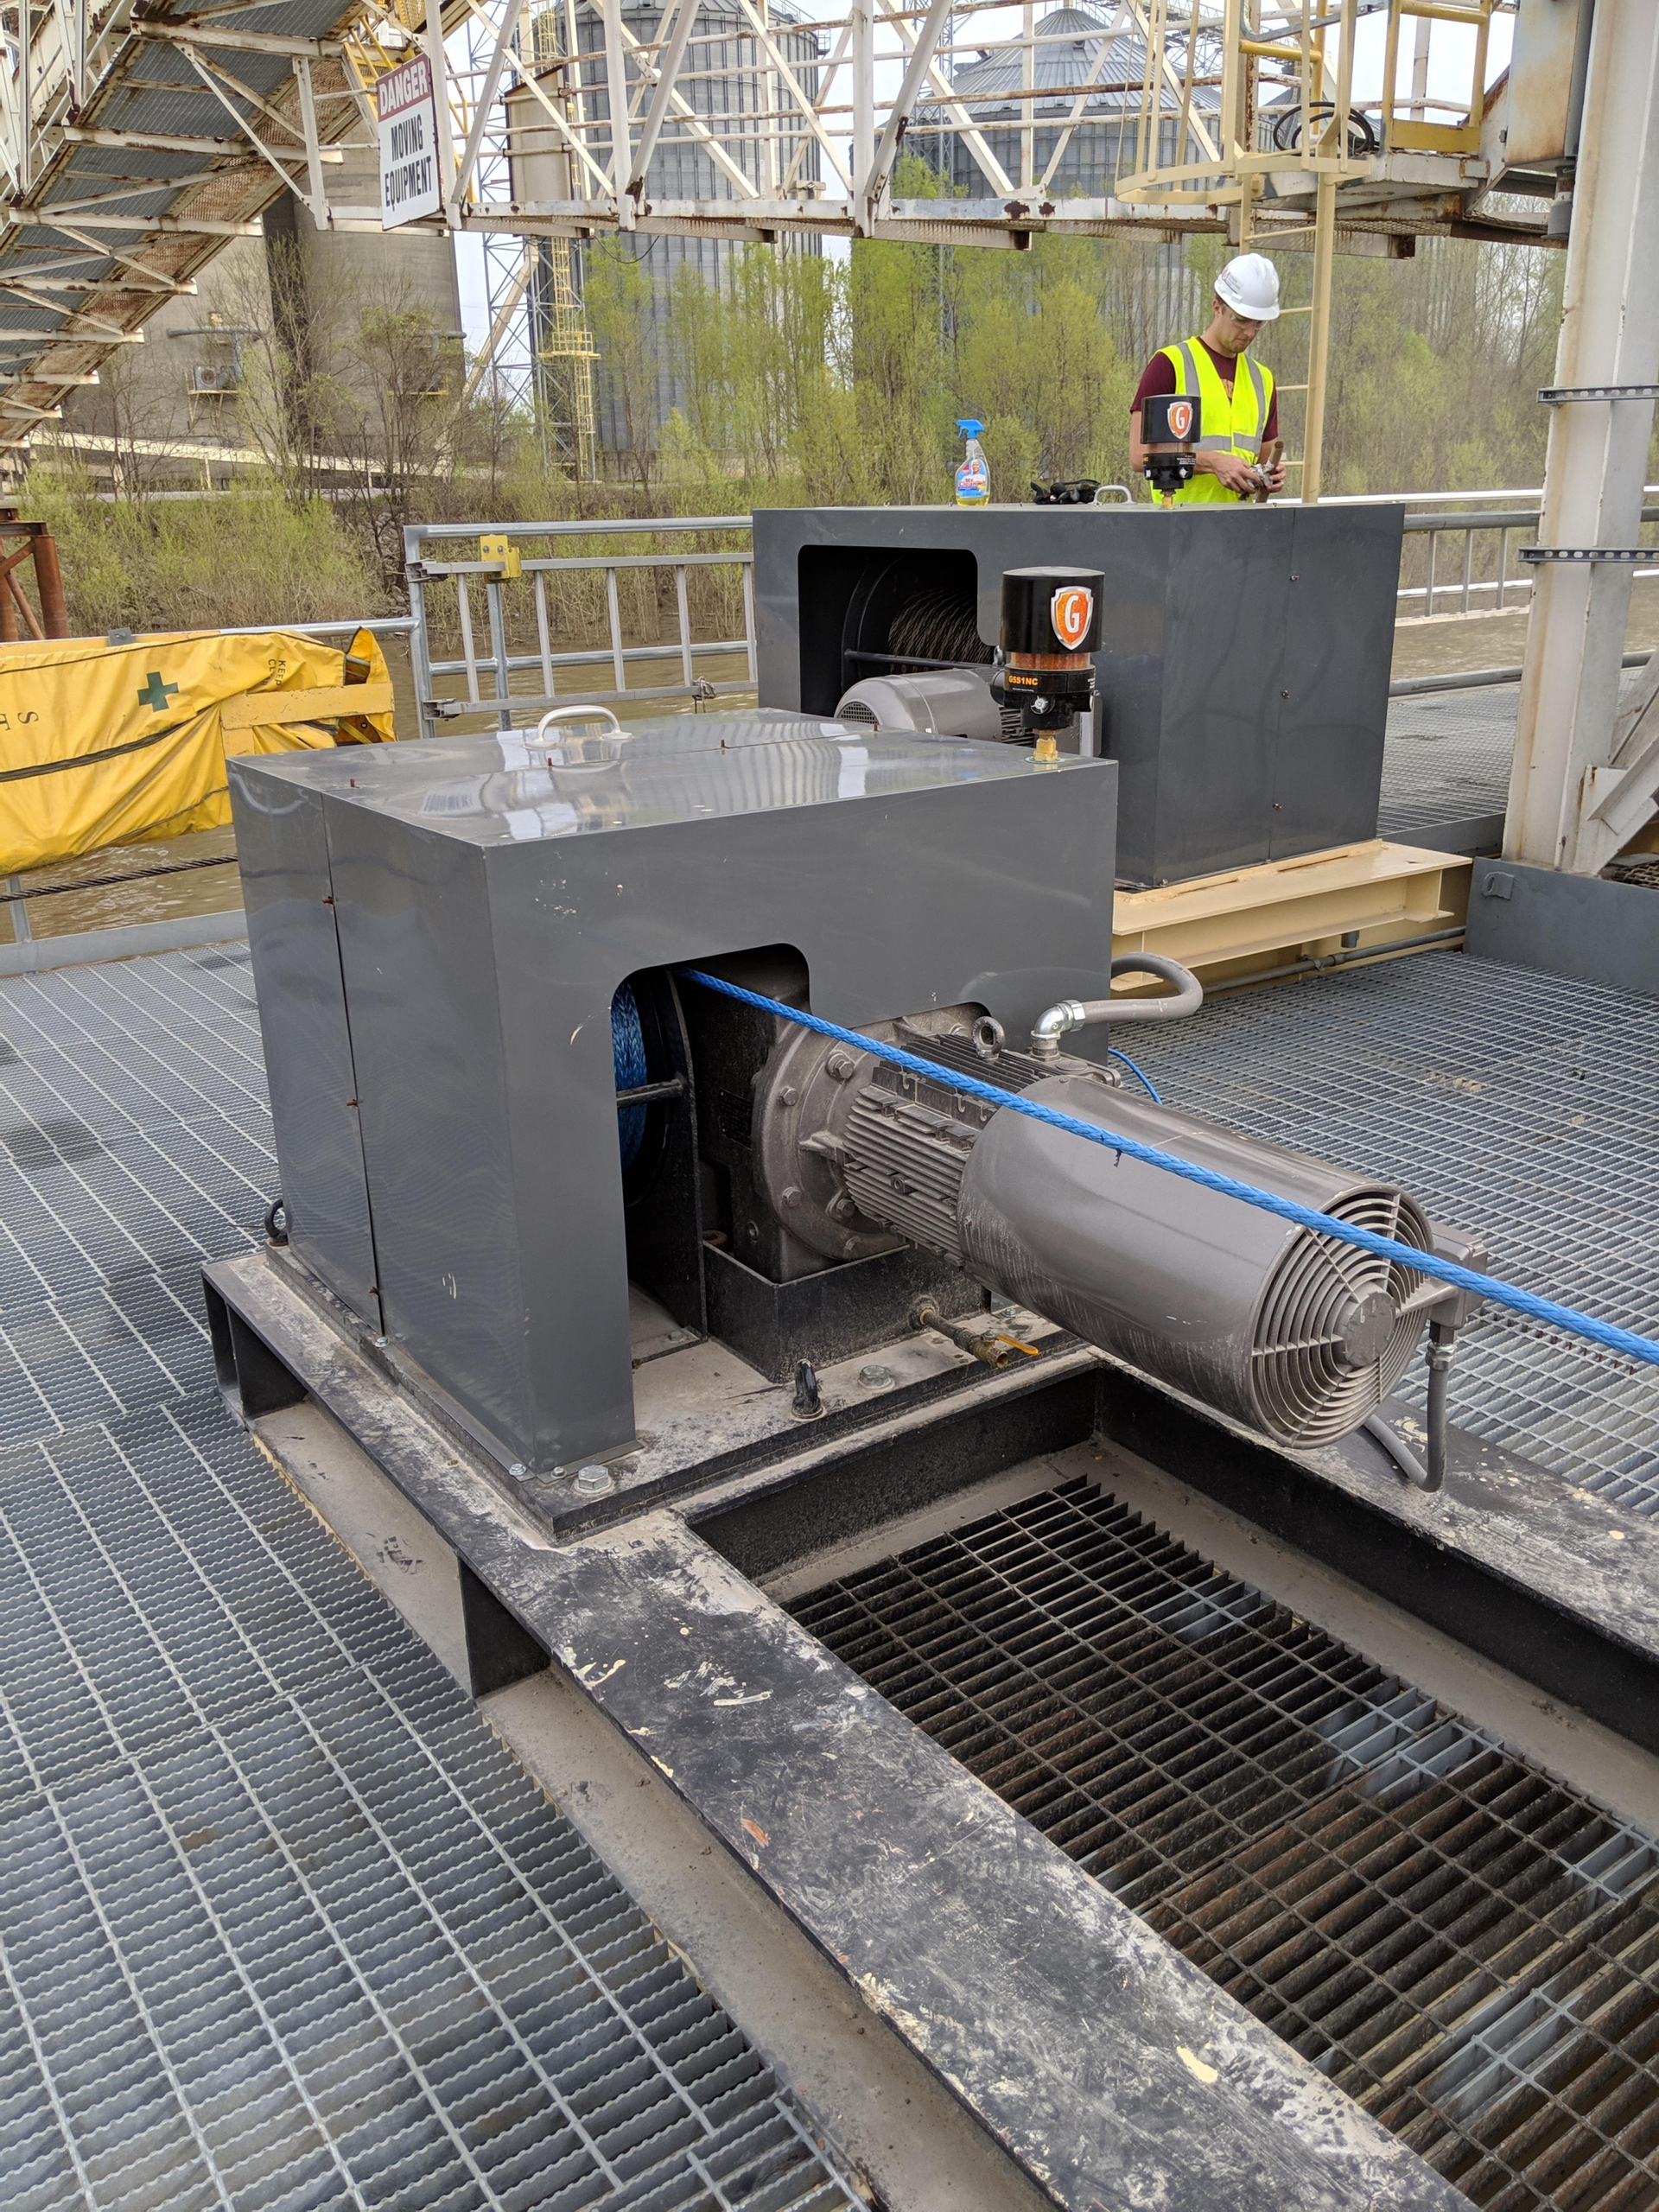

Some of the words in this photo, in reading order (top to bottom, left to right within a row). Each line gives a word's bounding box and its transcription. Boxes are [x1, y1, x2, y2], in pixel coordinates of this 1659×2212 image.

[379, 60, 429, 116] DANGER
[391, 113, 423, 162] MOVING
[385, 156, 432, 212] EQUIPMENT
[1175, 406, 1185, 429] G
[1065, 594, 1080, 633] G
[274, 660, 287, 686] KEEP
[1008, 675, 1039, 686] G5S1NC
